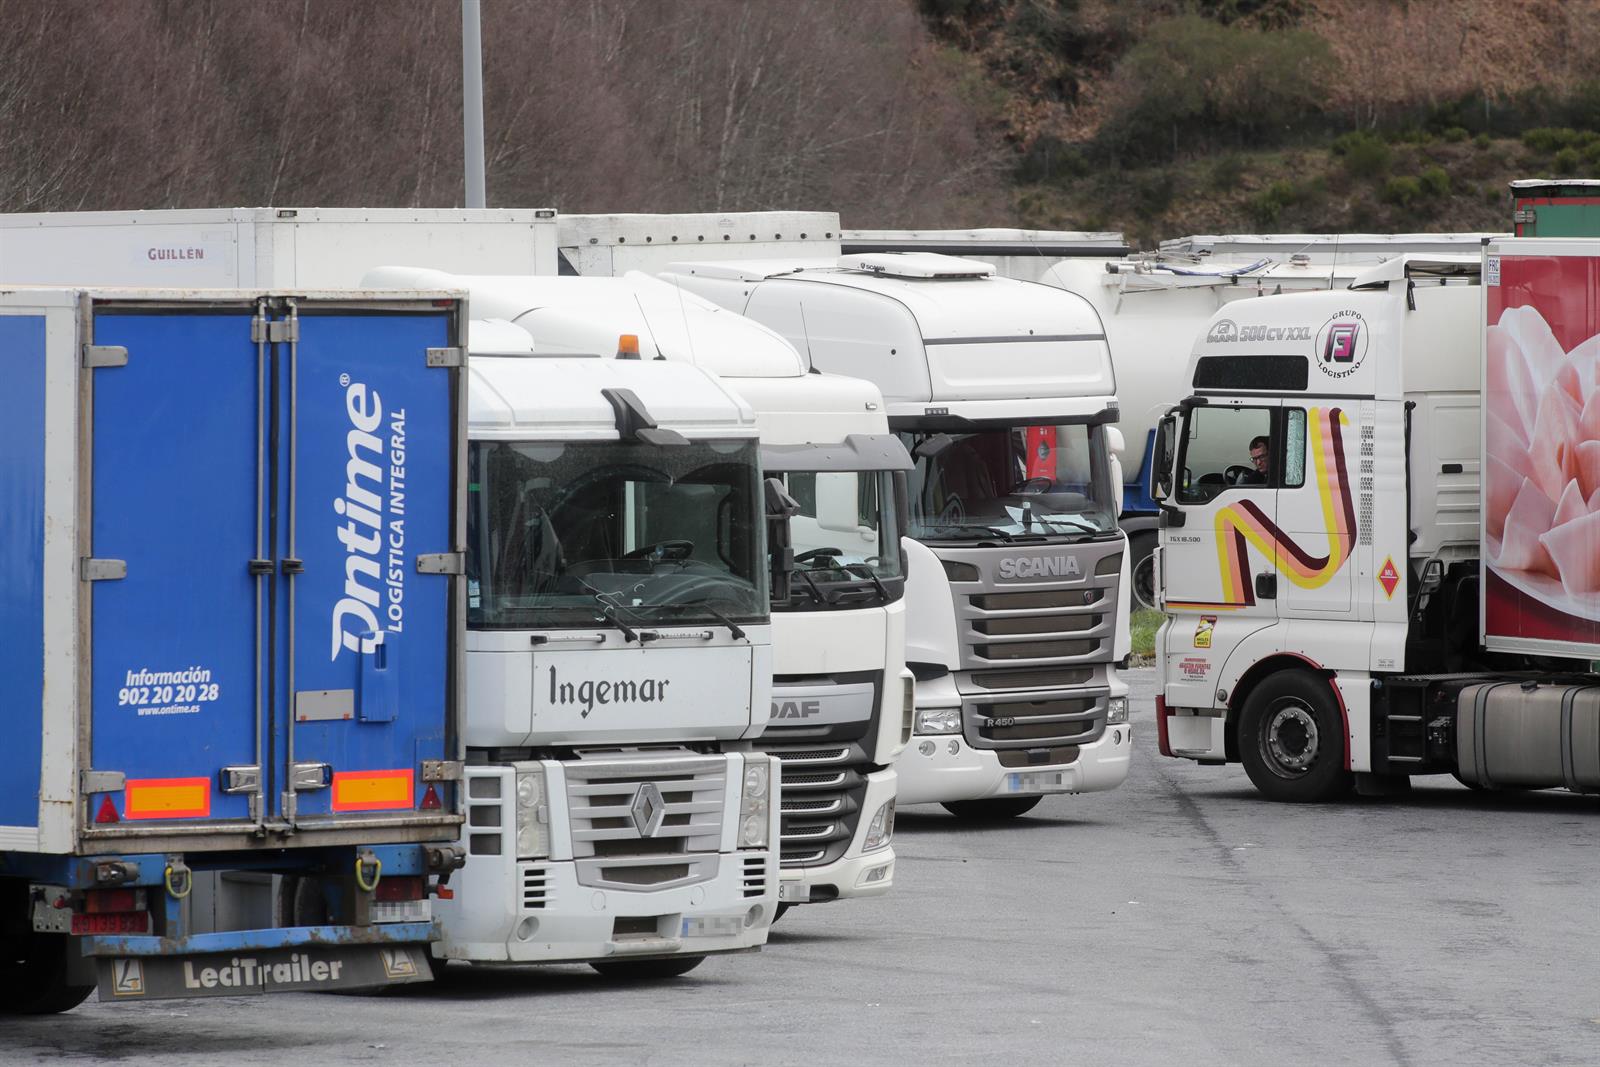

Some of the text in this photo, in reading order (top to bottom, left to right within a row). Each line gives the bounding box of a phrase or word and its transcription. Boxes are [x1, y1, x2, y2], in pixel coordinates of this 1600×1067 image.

[1332, 309, 1362, 320] GRUPO
[1317, 361, 1362, 379] LOGISTICO
[331, 382, 384, 662] Ontime
[385, 407, 406, 633] LOGÍSTICA INTEGRAL
[999, 555, 1080, 579] SCANIA
[125, 665, 211, 687] Información
[118, 683, 219, 706] 902 20 20 28
[549, 664, 670, 719] Ingemar
[137, 703, 200, 716] www.ontime.es
[987, 717, 1014, 727] R 450
[183, 953, 343, 989] LeciTrailer
